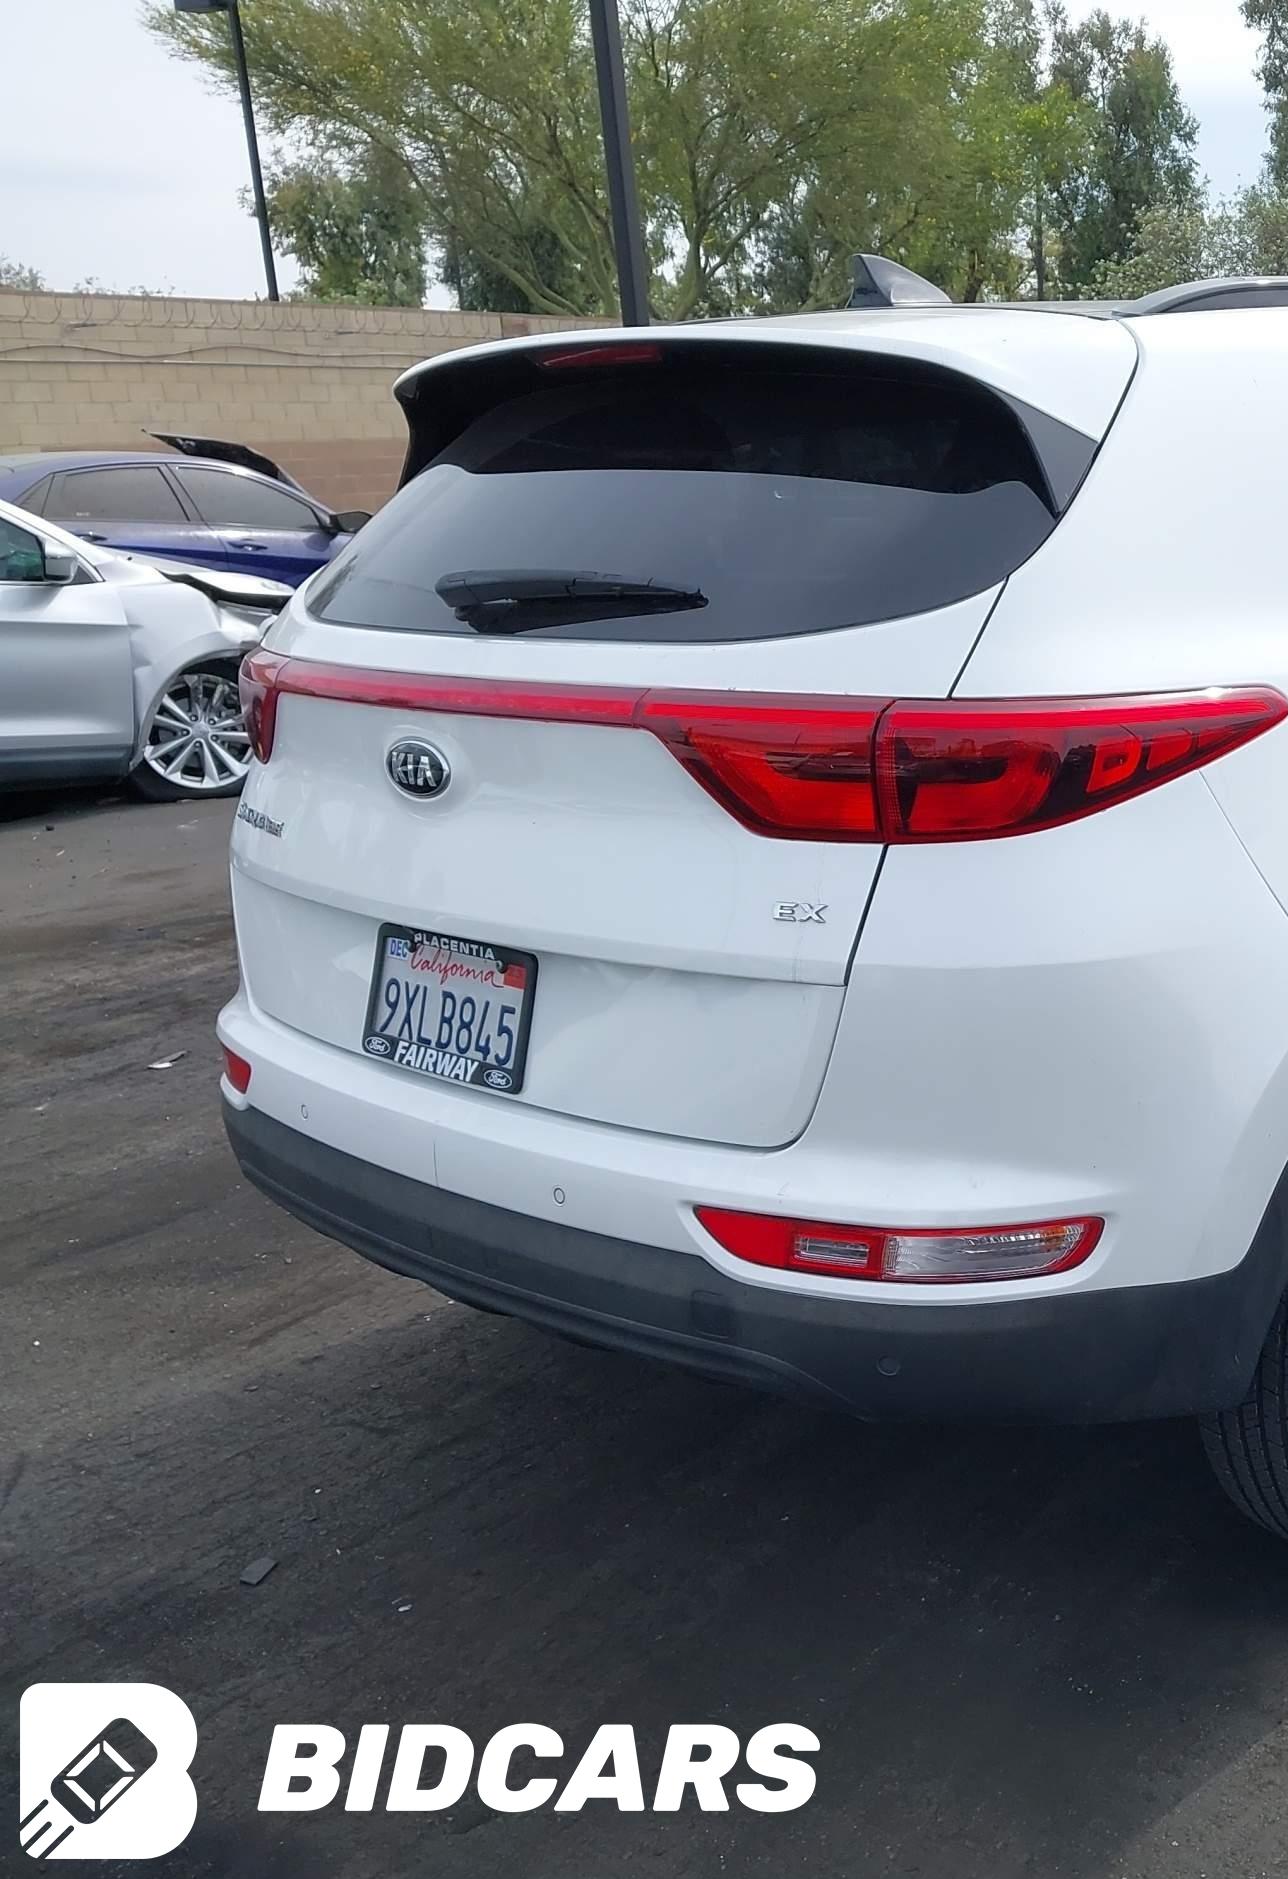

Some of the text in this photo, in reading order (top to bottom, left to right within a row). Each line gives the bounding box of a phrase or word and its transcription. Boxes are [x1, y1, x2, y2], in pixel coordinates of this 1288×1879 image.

[392, 751, 437, 787] KIA
[772, 901, 828, 923] EX
[391, 939, 408, 957] DEC
[414, 932, 495, 960] PLACENTIA
[411, 943, 504, 988] California
[379, 978, 516, 1067] 9XLB845
[393, 1040, 479, 1082] FAIRWAY
